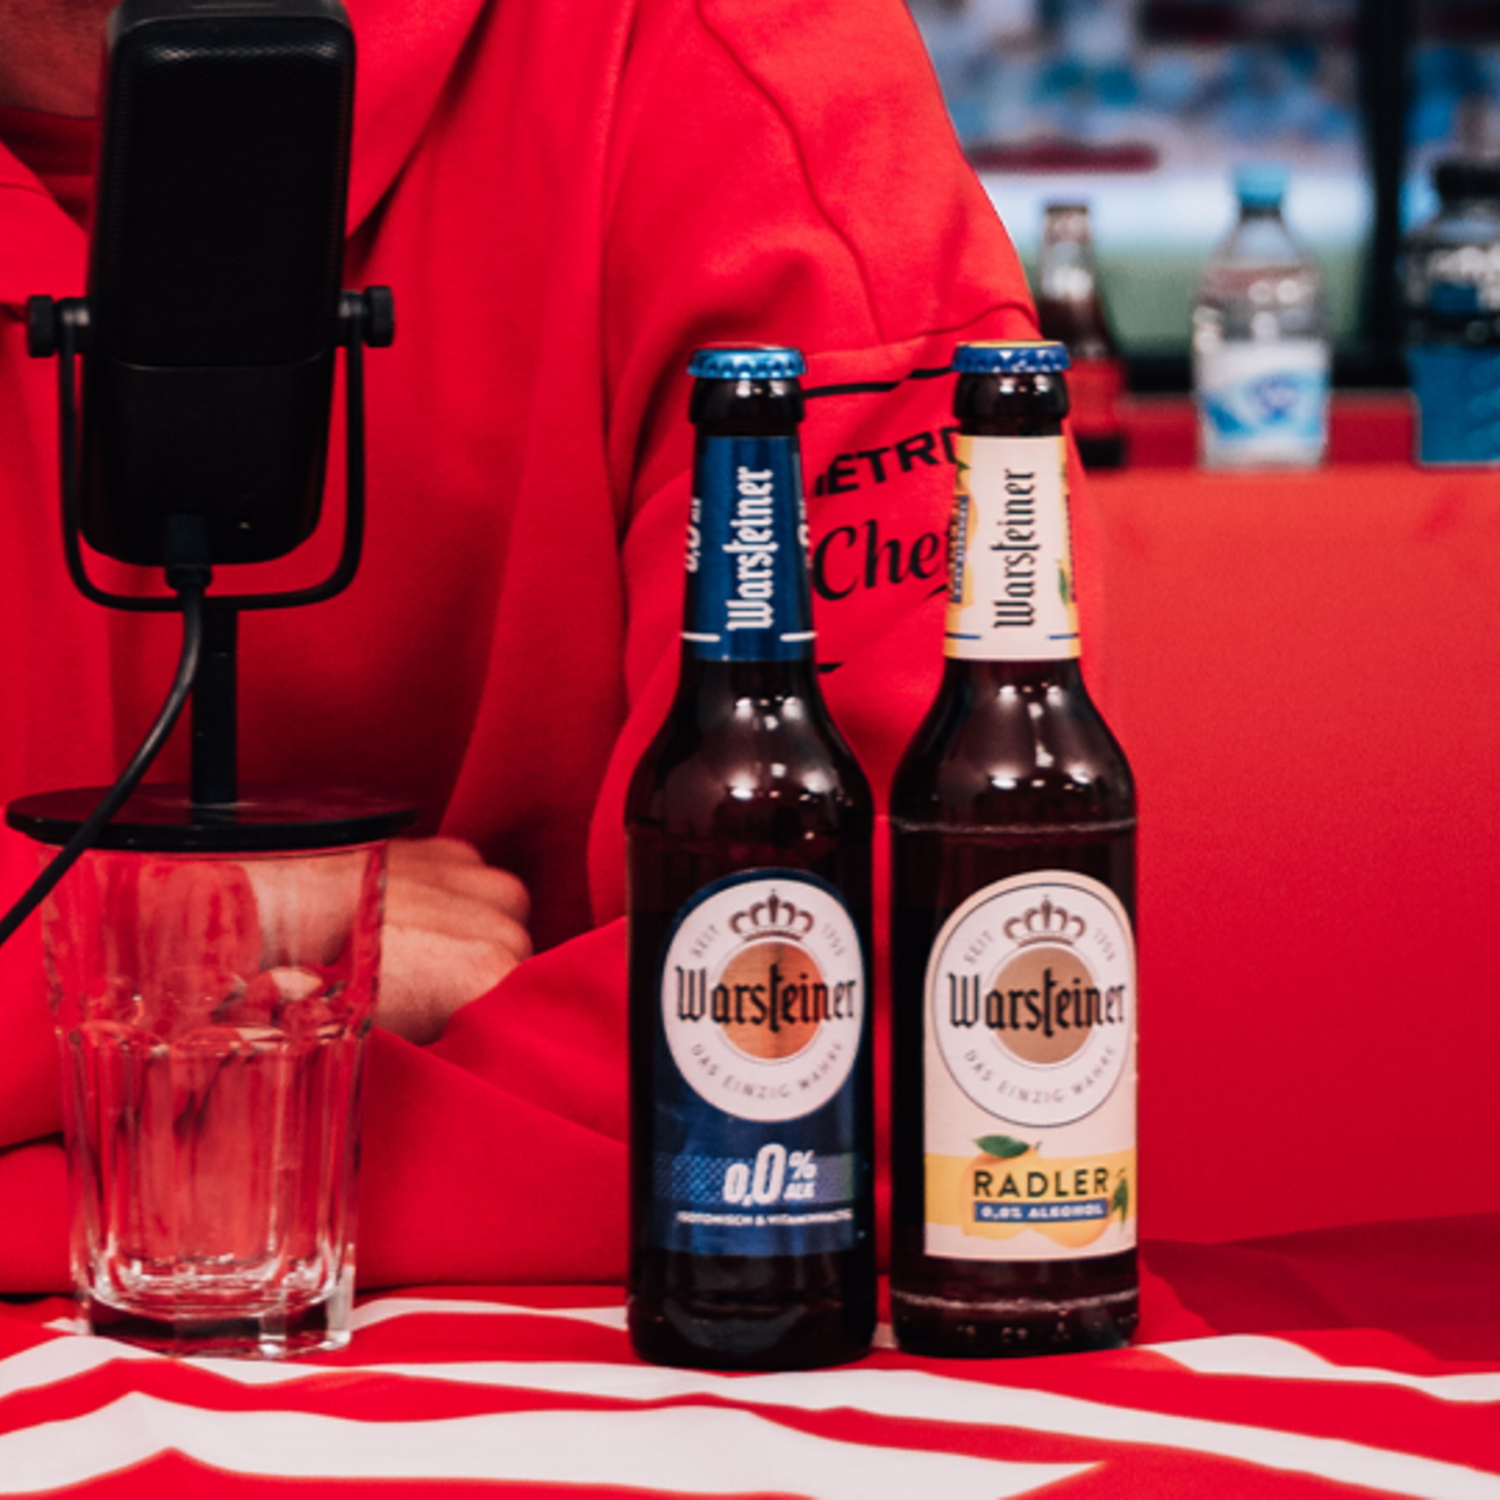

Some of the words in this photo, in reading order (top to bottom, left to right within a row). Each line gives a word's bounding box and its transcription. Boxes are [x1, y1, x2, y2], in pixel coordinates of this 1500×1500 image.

[722, 466, 779, 631] Warsteiner
[812, 518, 950, 601] Che
[989, 468, 1041, 629] Warsteiner
[675, 963, 857, 1033] Warsteiner
[947, 967, 1127, 1038] Warsteiner
[974, 1167, 1110, 1197] RADLER
